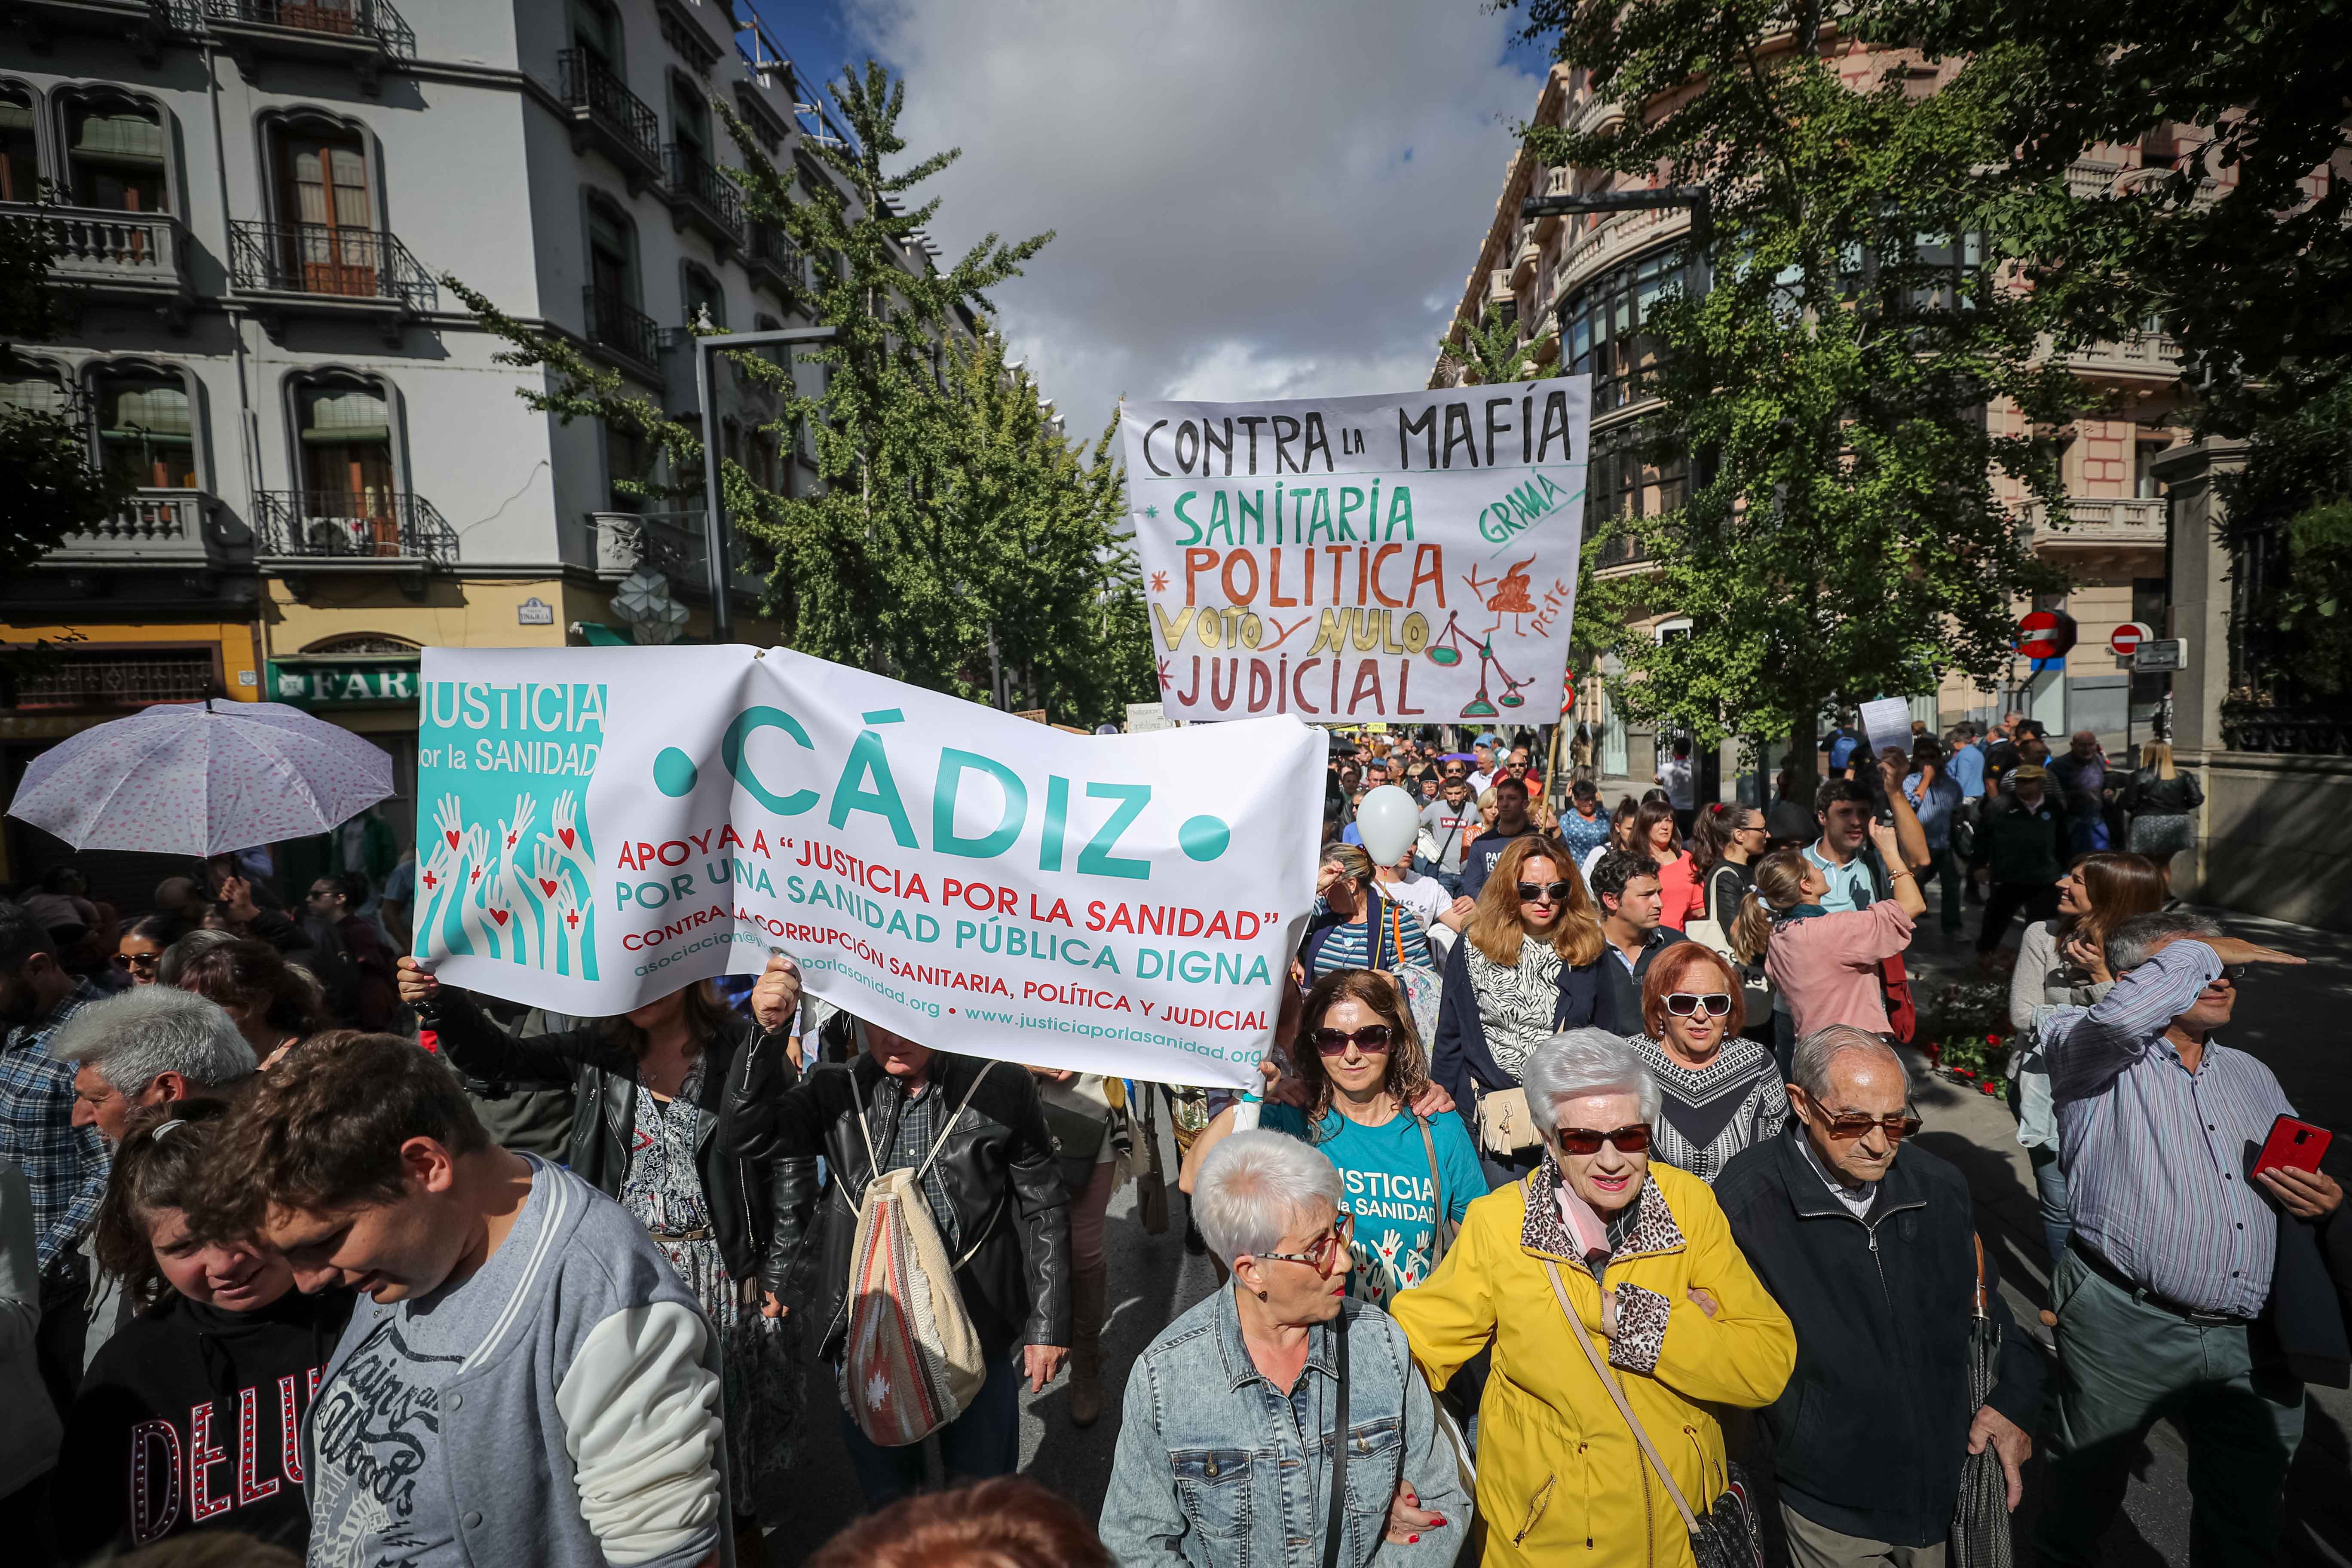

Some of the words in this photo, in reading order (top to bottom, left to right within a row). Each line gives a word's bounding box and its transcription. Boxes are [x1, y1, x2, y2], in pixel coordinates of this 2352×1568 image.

[1143, 411, 1333, 477] CONTRA
[1342, 428, 1365, 454] LA
[1399, 383, 1571, 470] MAFÍA
[1152, 603, 1262, 652] VOTO
[1307, 607, 1430, 657] NULO
[308, 668, 420, 701] FAR
[419, 681, 606, 733] JUSTICIA
[418, 749, 441, 768] or
[448, 743, 467, 770] la
[475, 738, 600, 776] SANIDAD
[721, 705, 1152, 881] CÁDIZ
[616, 873, 694, 911] POR
[705, 857, 777, 899] UNA
[787, 875, 940, 944] SANIDAD
[956, 916, 1121, 975] PÚBLICA
[1136, 948, 1272, 986] DIGNA
[617, 824, 742, 871] APOYA
[752, 829, 772, 859] A
[943, 877, 1018, 916] POR
[1030, 893, 1074, 928] LA
[622, 904, 726, 951] CONTRA
[731, 902, 753, 924] LA
[754, 914, 884, 969] CORRUPCIÓN
[1023, 982, 1132, 1013] POLÍTICA
[1139, 1000, 1156, 1017] Y
[1161, 1005, 1268, 1031] JUDICIAL
[965, 1006, 1262, 1066] www.justiciaporlasanidad.org
[1355, 1197, 1436, 1225] SANIDAD
[340, 1328, 416, 1433] lains
[132, 1362, 330, 1546] DELU
[319, 1391, 426, 1517] Woods
